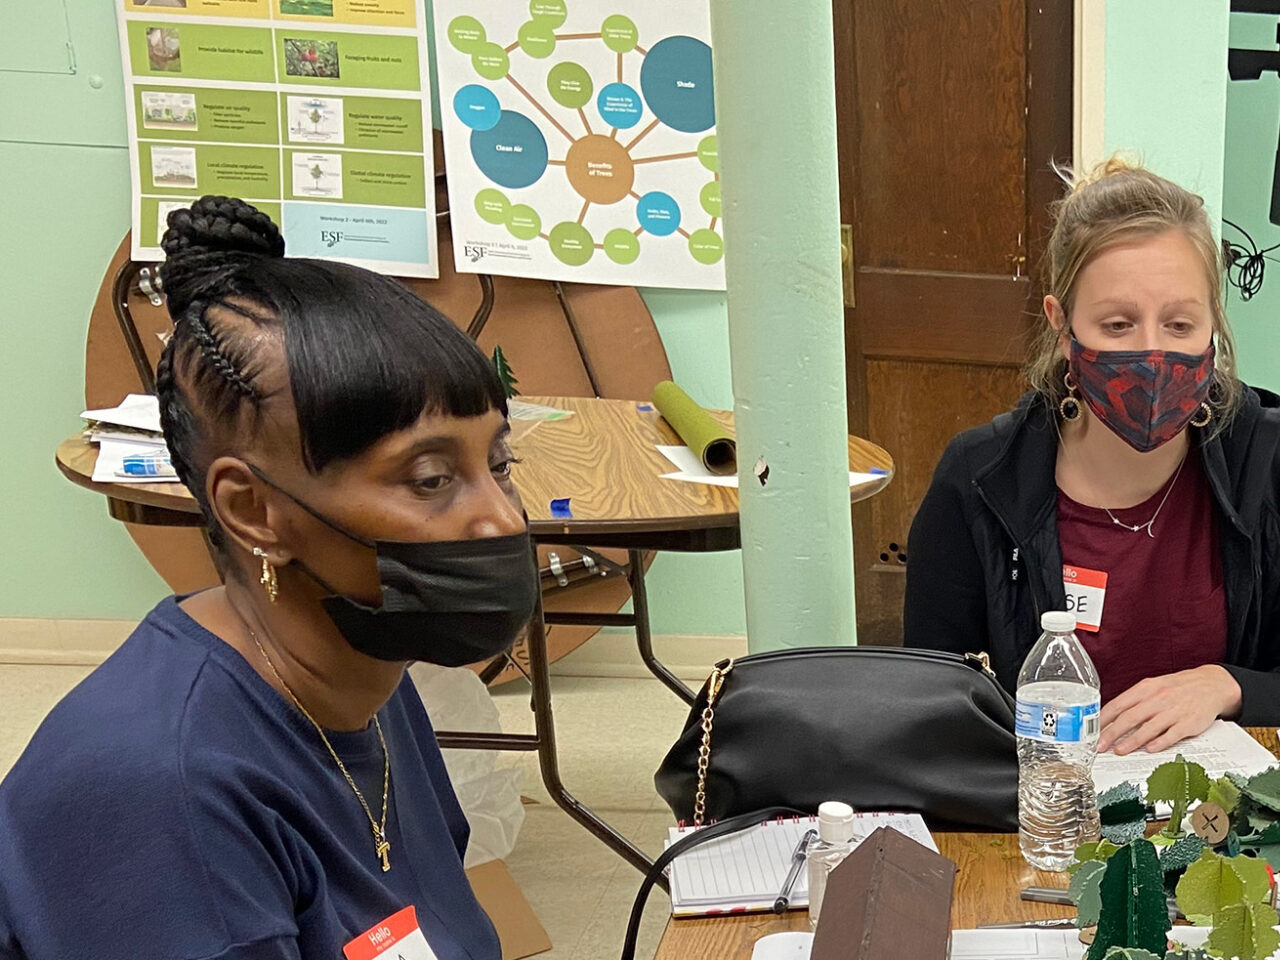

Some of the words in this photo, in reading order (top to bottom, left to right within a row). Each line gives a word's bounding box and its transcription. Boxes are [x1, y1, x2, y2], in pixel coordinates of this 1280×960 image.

[676, 80, 695, 88] Shade
[495, 144, 513, 152] Clean
[513, 145, 523, 153] Air
[597, 170, 613, 178] Trees
[320, 230, 344, 243] ESF
[464, 245, 488, 258] ESF
[368, 926, 391, 946] Hello
